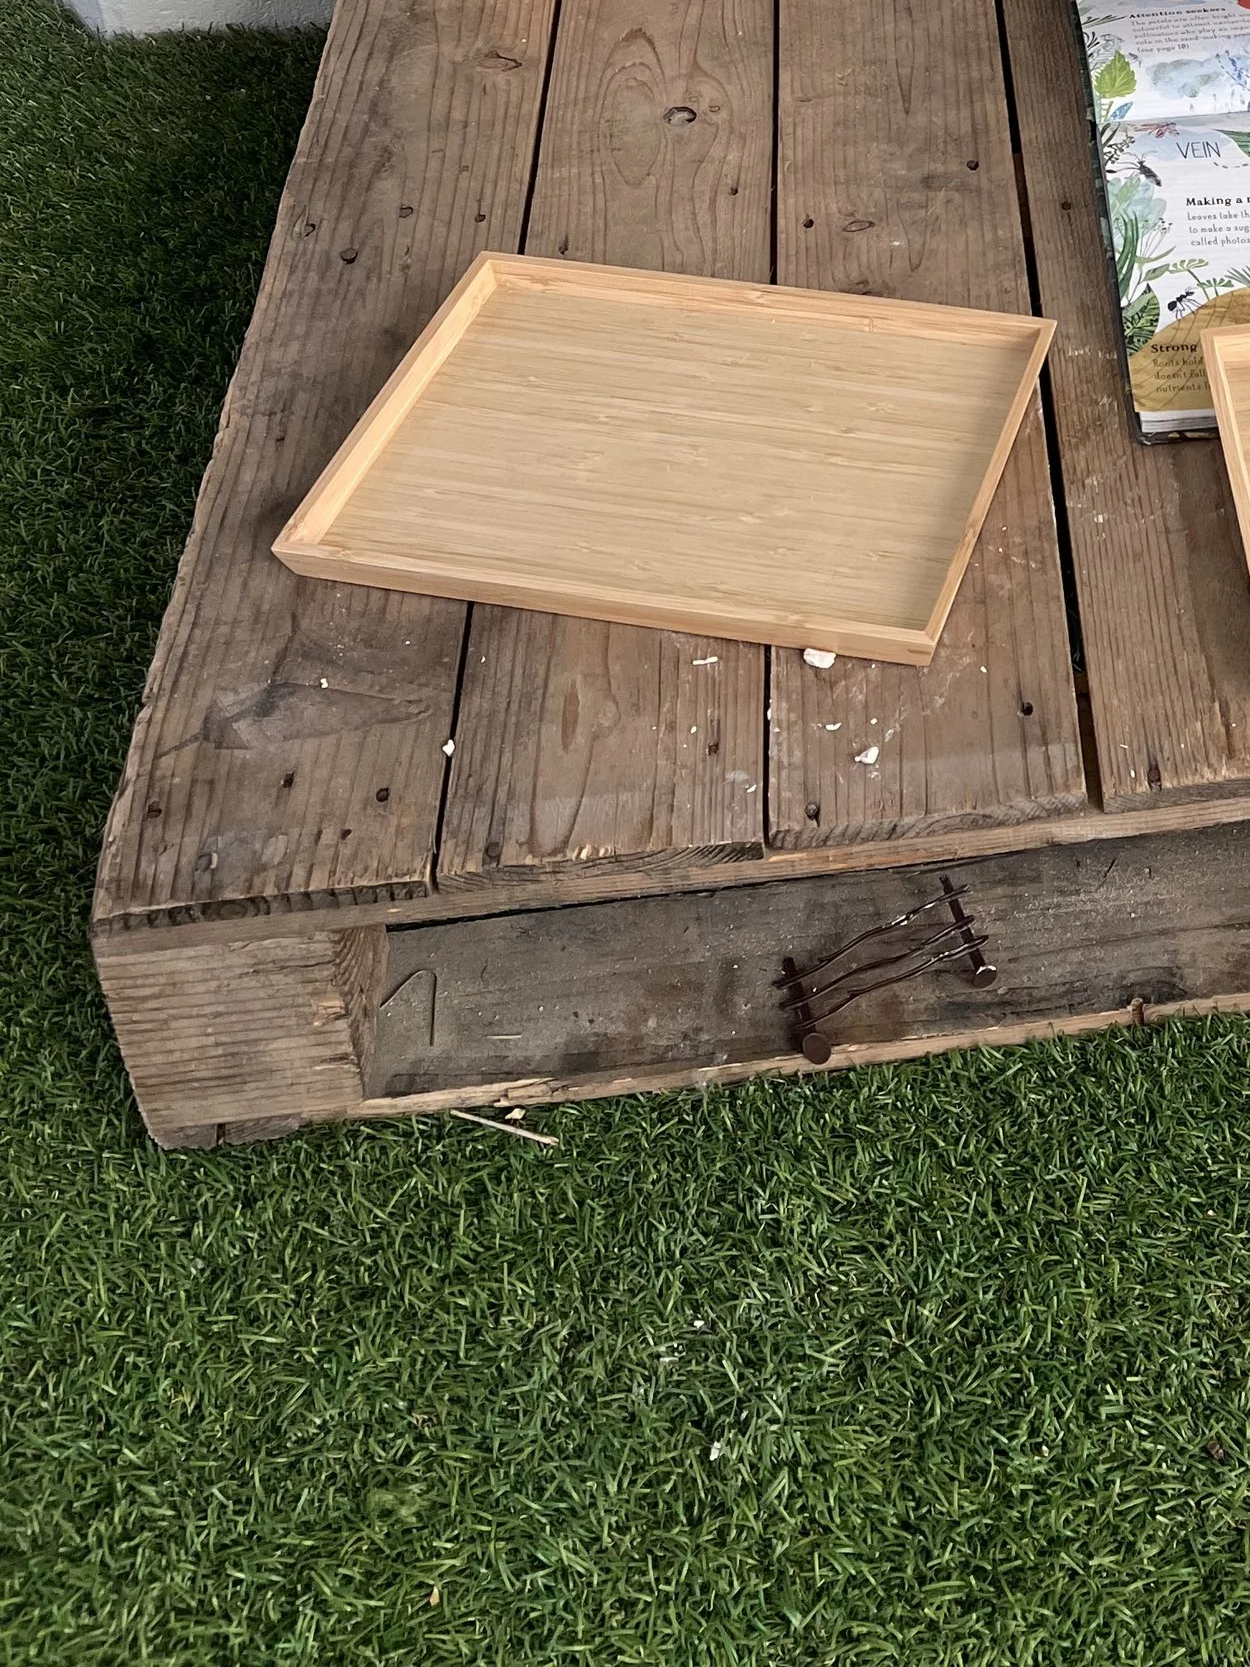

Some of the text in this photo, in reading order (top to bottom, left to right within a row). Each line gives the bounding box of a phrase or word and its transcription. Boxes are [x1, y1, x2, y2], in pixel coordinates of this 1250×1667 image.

[1129, 10, 1182, 19] Attention
[1176, 141, 1222, 158] VEIN
[1186, 196, 1232, 207] Making
[1187, 212, 1216, 221] Leaves
[1220, 211, 1238, 220] take
[1189, 226, 1198, 234] to
[1200, 224, 1223, 233] make
[1190, 237, 1218, 246] called
[1151, 344, 1197, 354] Strong
